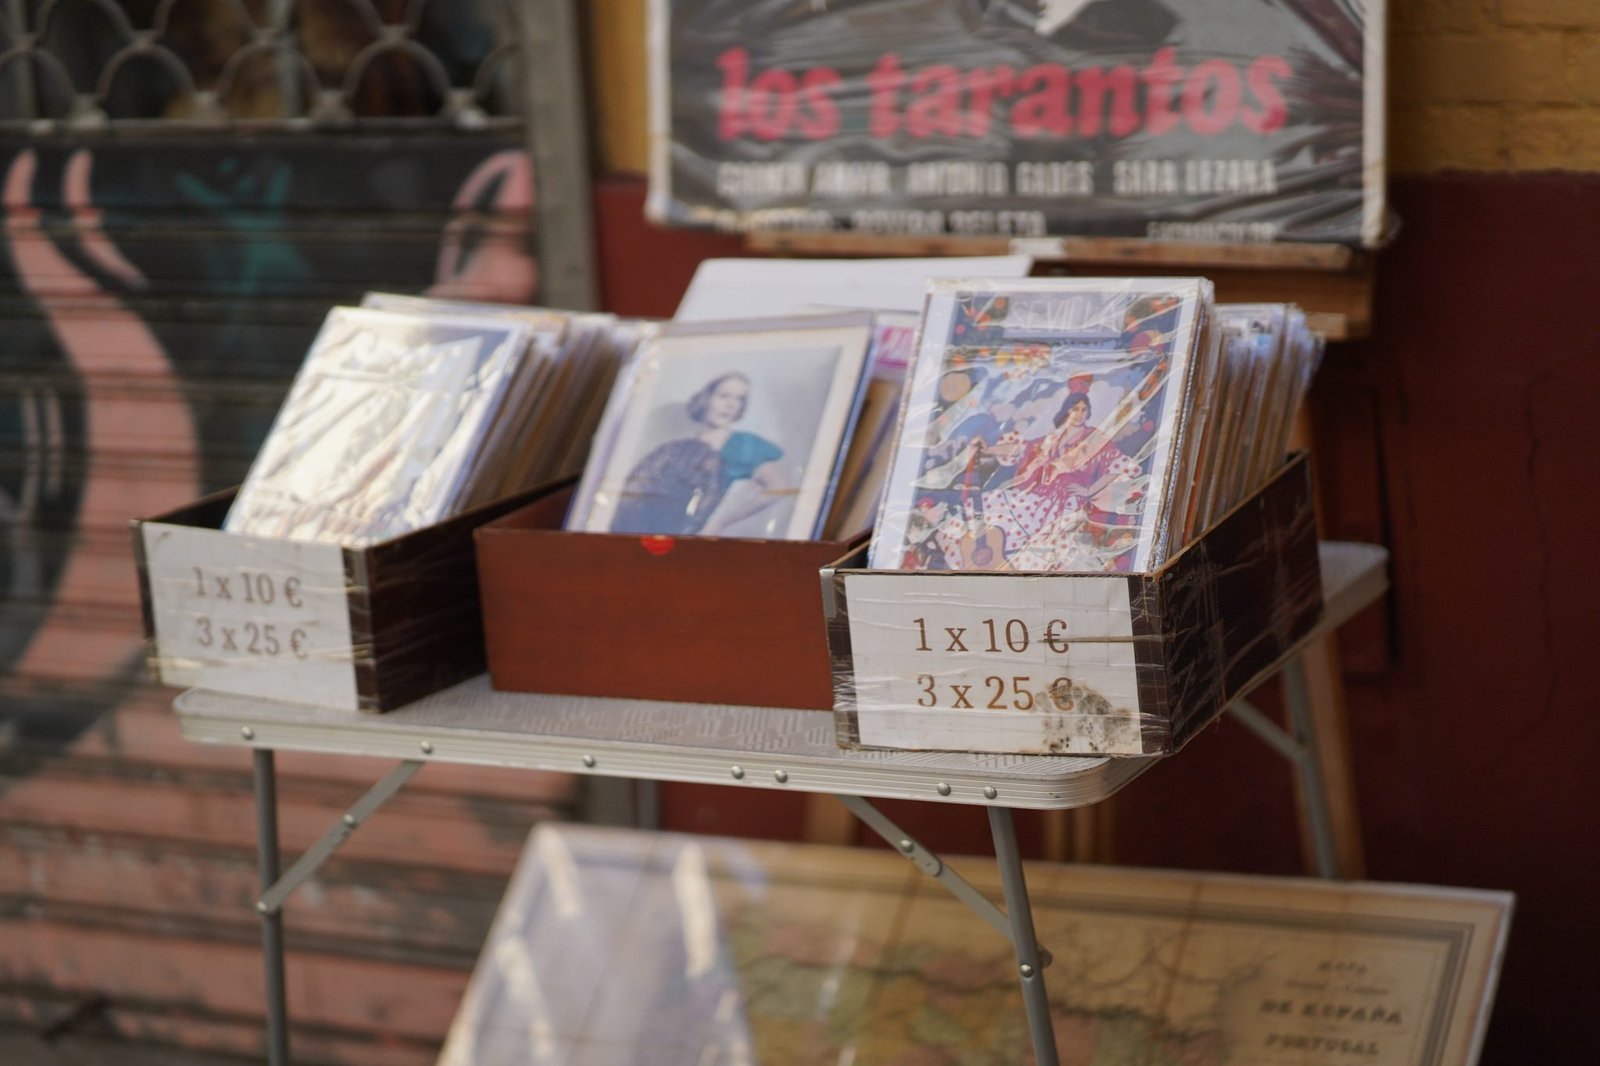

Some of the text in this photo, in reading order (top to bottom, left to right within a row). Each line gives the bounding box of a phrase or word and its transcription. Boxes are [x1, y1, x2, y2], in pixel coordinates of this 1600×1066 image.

[715, 46, 1294, 142] los tarantos
[1113, 159, 1178, 195] SARA
[193, 566, 206, 597] 1
[240, 571, 275, 604] 10
[284, 576, 304, 609] €
[196, 616, 214, 648] 3
[243, 622, 281, 656] 25
[290, 627, 309, 660] €
[912, 617, 1070, 654] 1 x 10 €
[916, 674, 937, 708] 3
[951, 685, 974, 709] x
[984, 676, 1035, 711] 25
